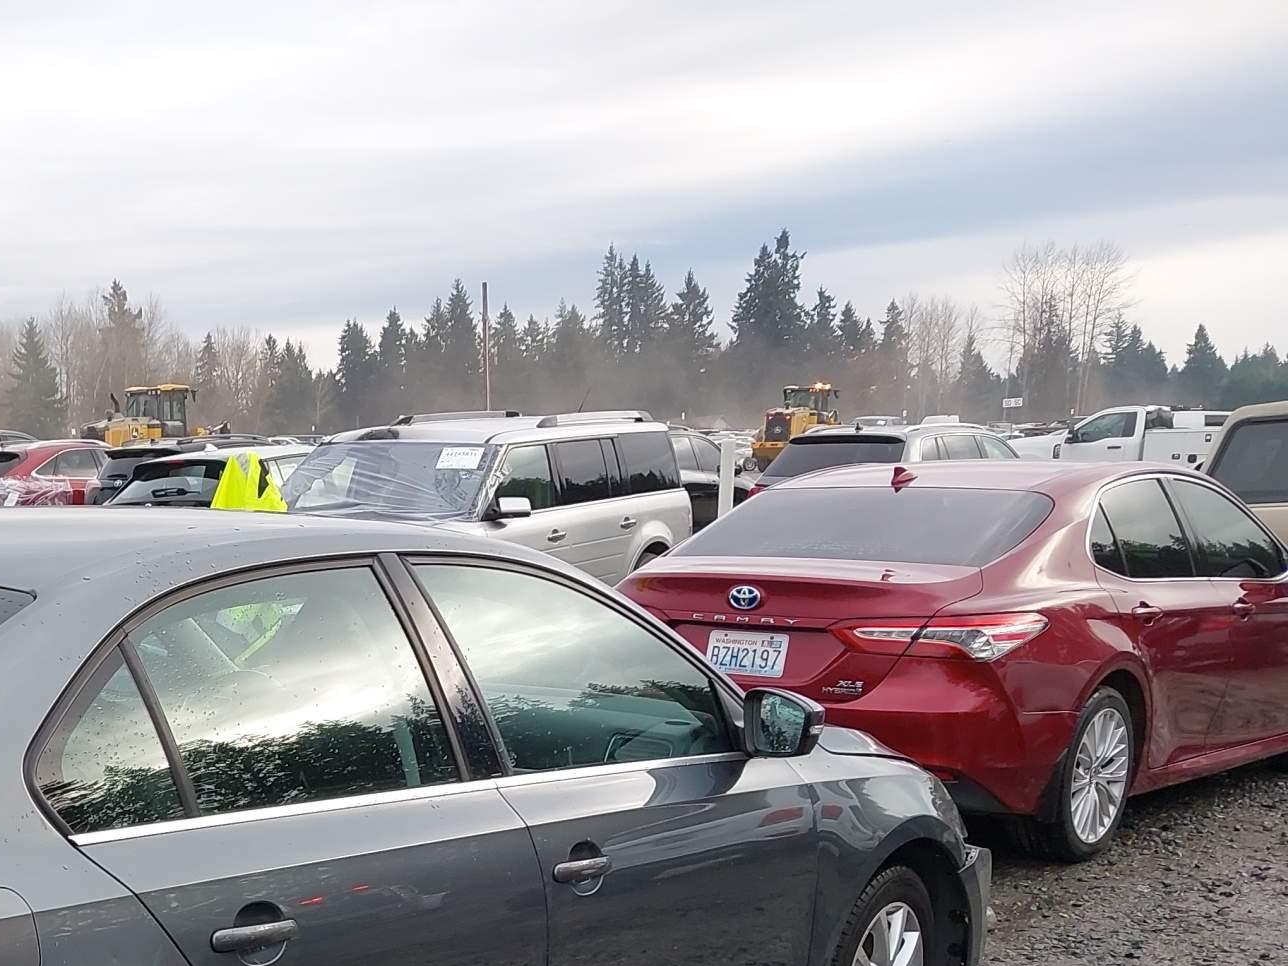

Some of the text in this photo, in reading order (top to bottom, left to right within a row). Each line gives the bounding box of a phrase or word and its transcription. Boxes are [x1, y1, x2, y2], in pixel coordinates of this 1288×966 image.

[692, 613, 801, 625] CAMRY
[715, 638, 758, 647] WASHINGTON
[710, 645, 782, 670] BZH2197
[835, 680, 864, 688] XLE
